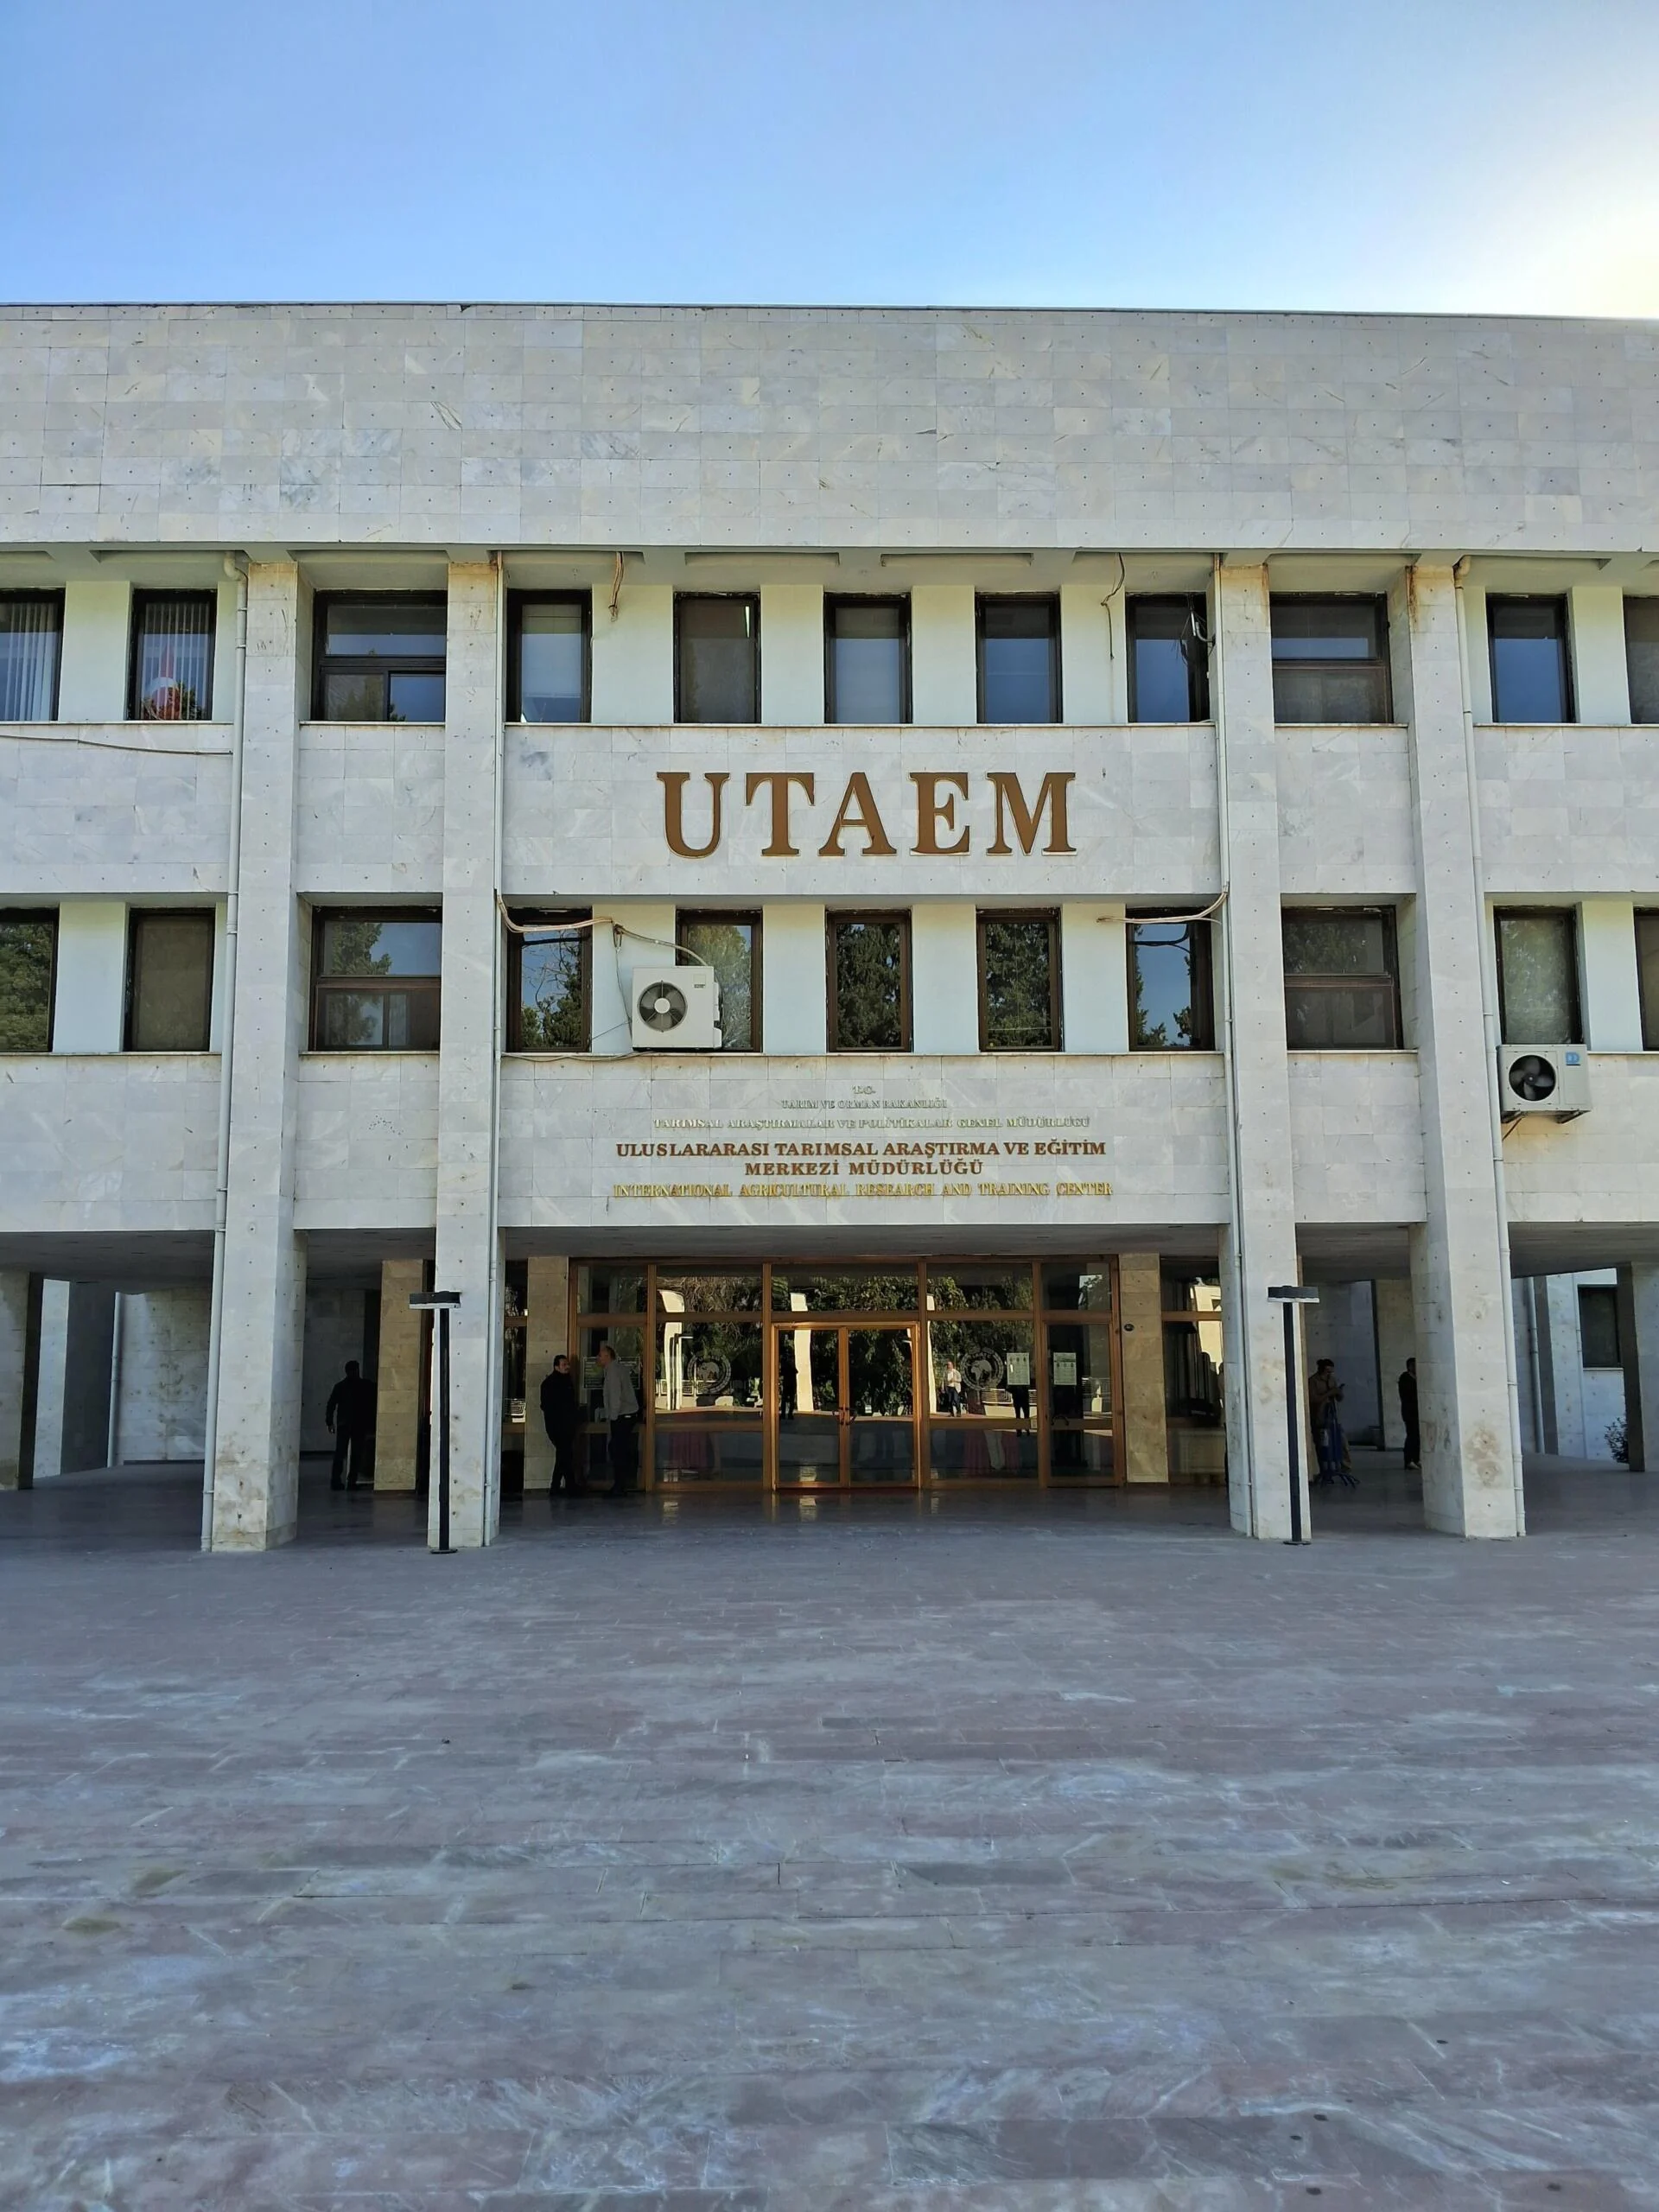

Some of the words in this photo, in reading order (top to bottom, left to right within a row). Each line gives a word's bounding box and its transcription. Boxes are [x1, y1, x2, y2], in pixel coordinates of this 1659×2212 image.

[656, 771, 1077, 859] UTAEM
[782, 1100, 818, 1109] TARIM
[822, 1100, 836, 1109] VE
[838, 1100, 880, 1109] ORMAN
[653, 1119, 723, 1128] TARIMSAL
[728, 1119, 835, 1131] ARAŞTIRMALAR
[837, 1119, 855, 1128] VE
[859, 1116, 952, 1128] POLİTİKALAR
[957, 1118, 1002, 1128] GENEL
[616, 1143, 769, 1157] ULUSLARARASI
[774, 1142, 878, 1156] TARIMSAL
[882, 1142, 1000, 1159] ARAŞTIRMA
[1003, 1142, 1029, 1155] VE
[1034, 1139, 1106, 1155] EĞİTİM
[745, 1160, 839, 1175] MERKEZİ
[849, 1159, 983, 1175] MÜDÜRLÜĞÜ
[613, 1185, 731, 1198] INTERNATIONAL
[740, 1184, 848, 1197] AGRICULTURAL
[855, 1184, 934, 1196] RESEARCH
[942, 1184, 971, 1196] AND
[977, 1183, 1050, 1196] TRAINING
[1056, 1183, 1112, 1195] CENTER
